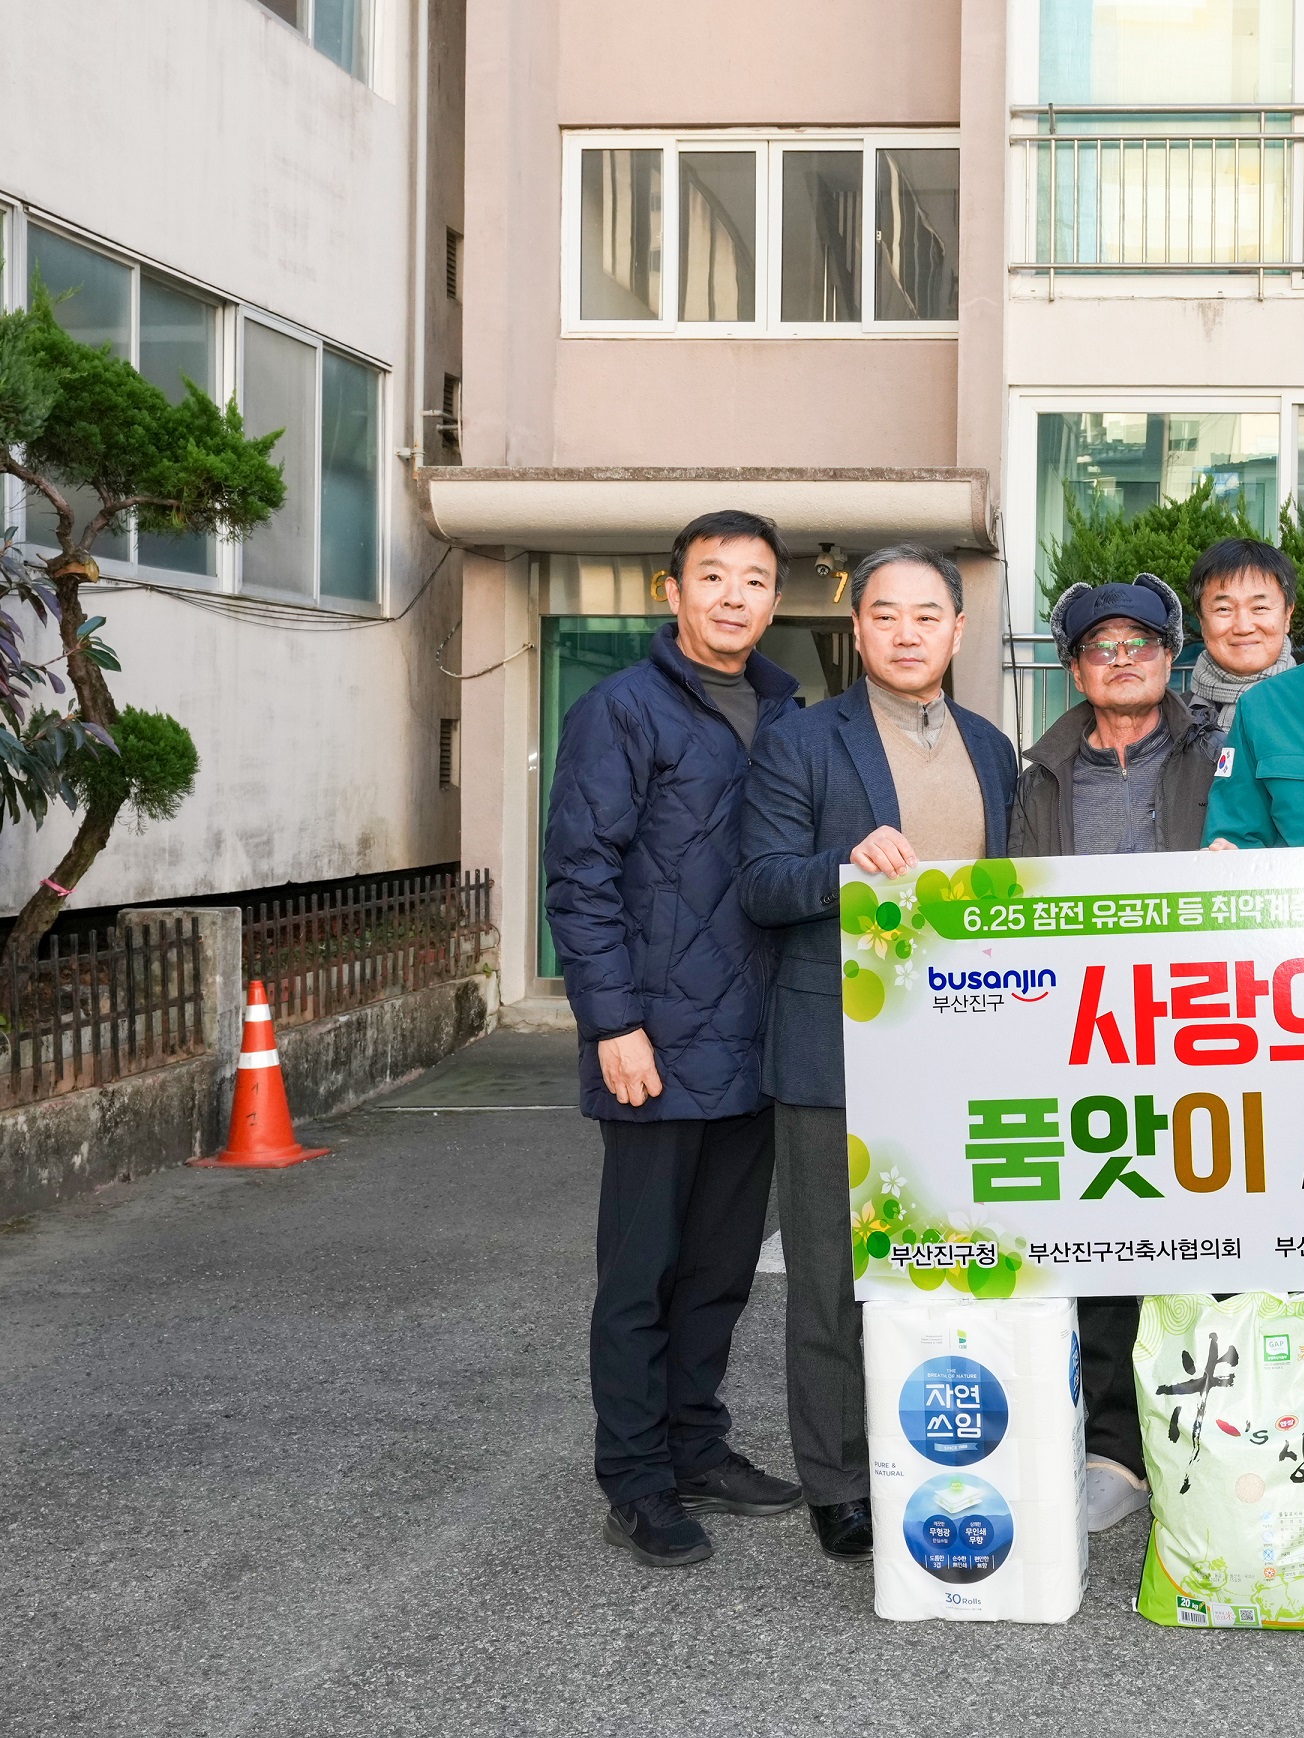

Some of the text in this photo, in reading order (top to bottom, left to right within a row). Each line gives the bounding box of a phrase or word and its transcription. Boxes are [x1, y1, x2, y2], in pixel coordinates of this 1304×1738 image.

[831, 571, 849, 604] 7
[963, 905, 1025, 932] 6.25
[1032, 902, 1084, 931] 참전
[1091, 898, 1172, 928] 유공자
[1177, 897, 1203, 925] 등
[928, 966, 1057, 995] busanjin
[932, 994, 1005, 1014] 부산진구
[964, 1091, 1266, 1203] 품앗이
[890, 1242, 996, 1267] 부산진구청
[1027, 1237, 1242, 1264] 부산진구건축사협의회
[925, 1383, 981, 1410] 자연
[874, 1461, 890, 1469] PURE
[874, 1469, 905, 1477] NATURAL
[945, 1592, 962, 1605] 30
[1180, 1597, 1191, 1608] 20
